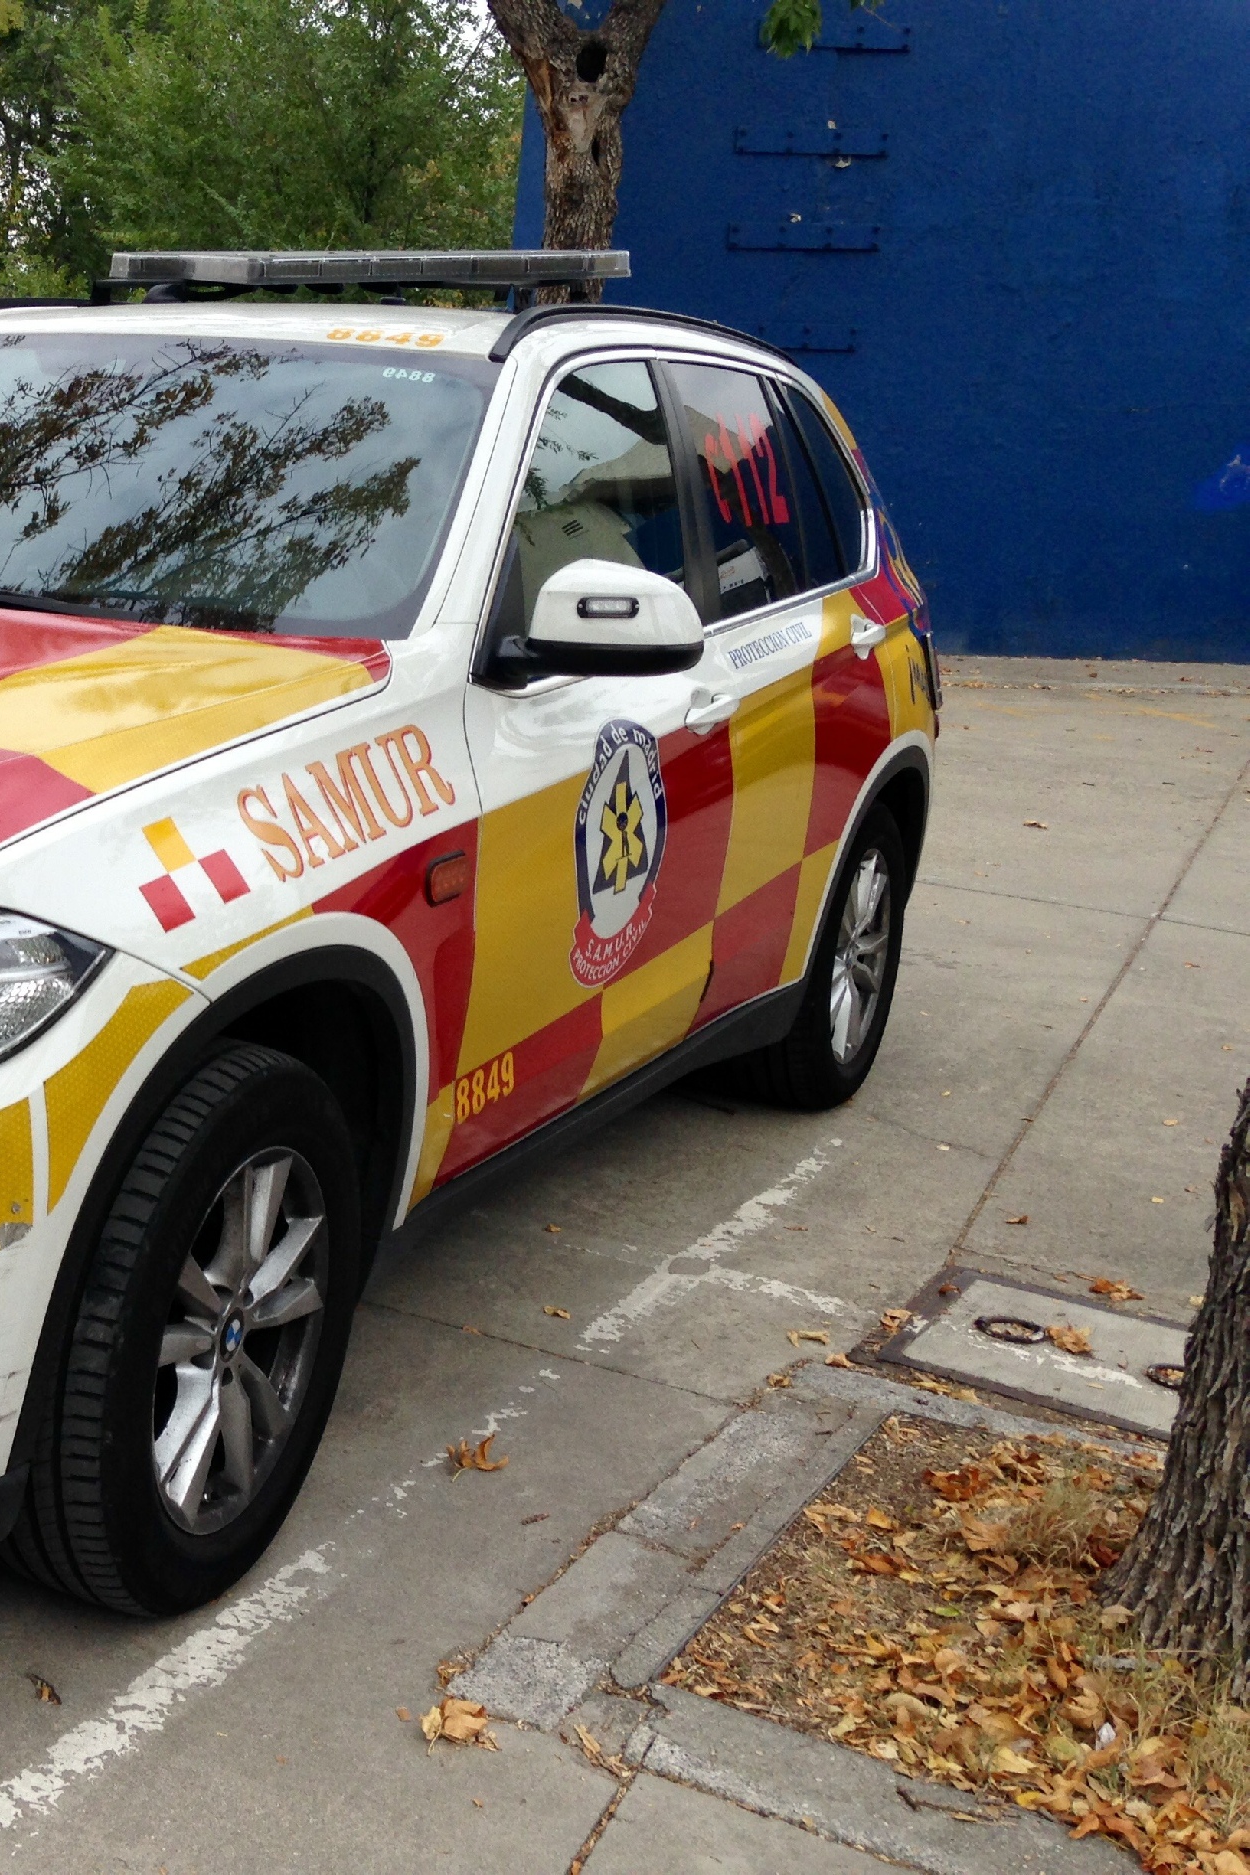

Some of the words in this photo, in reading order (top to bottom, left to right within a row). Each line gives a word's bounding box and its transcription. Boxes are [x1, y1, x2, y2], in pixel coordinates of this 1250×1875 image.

[326, 328, 444, 347] 8849
[718, 413, 789, 527] 112
[728, 630, 790, 670] PROTECCION
[785, 622, 812, 645] CIVIL
[237, 724, 456, 883] SAMUR
[579, 735, 613, 825] ciudad
[611, 723, 629, 745] de
[633, 728, 662, 801] madrid
[573, 948, 620, 980] PROTECCION
[456, 1051, 515, 1124] 8849
